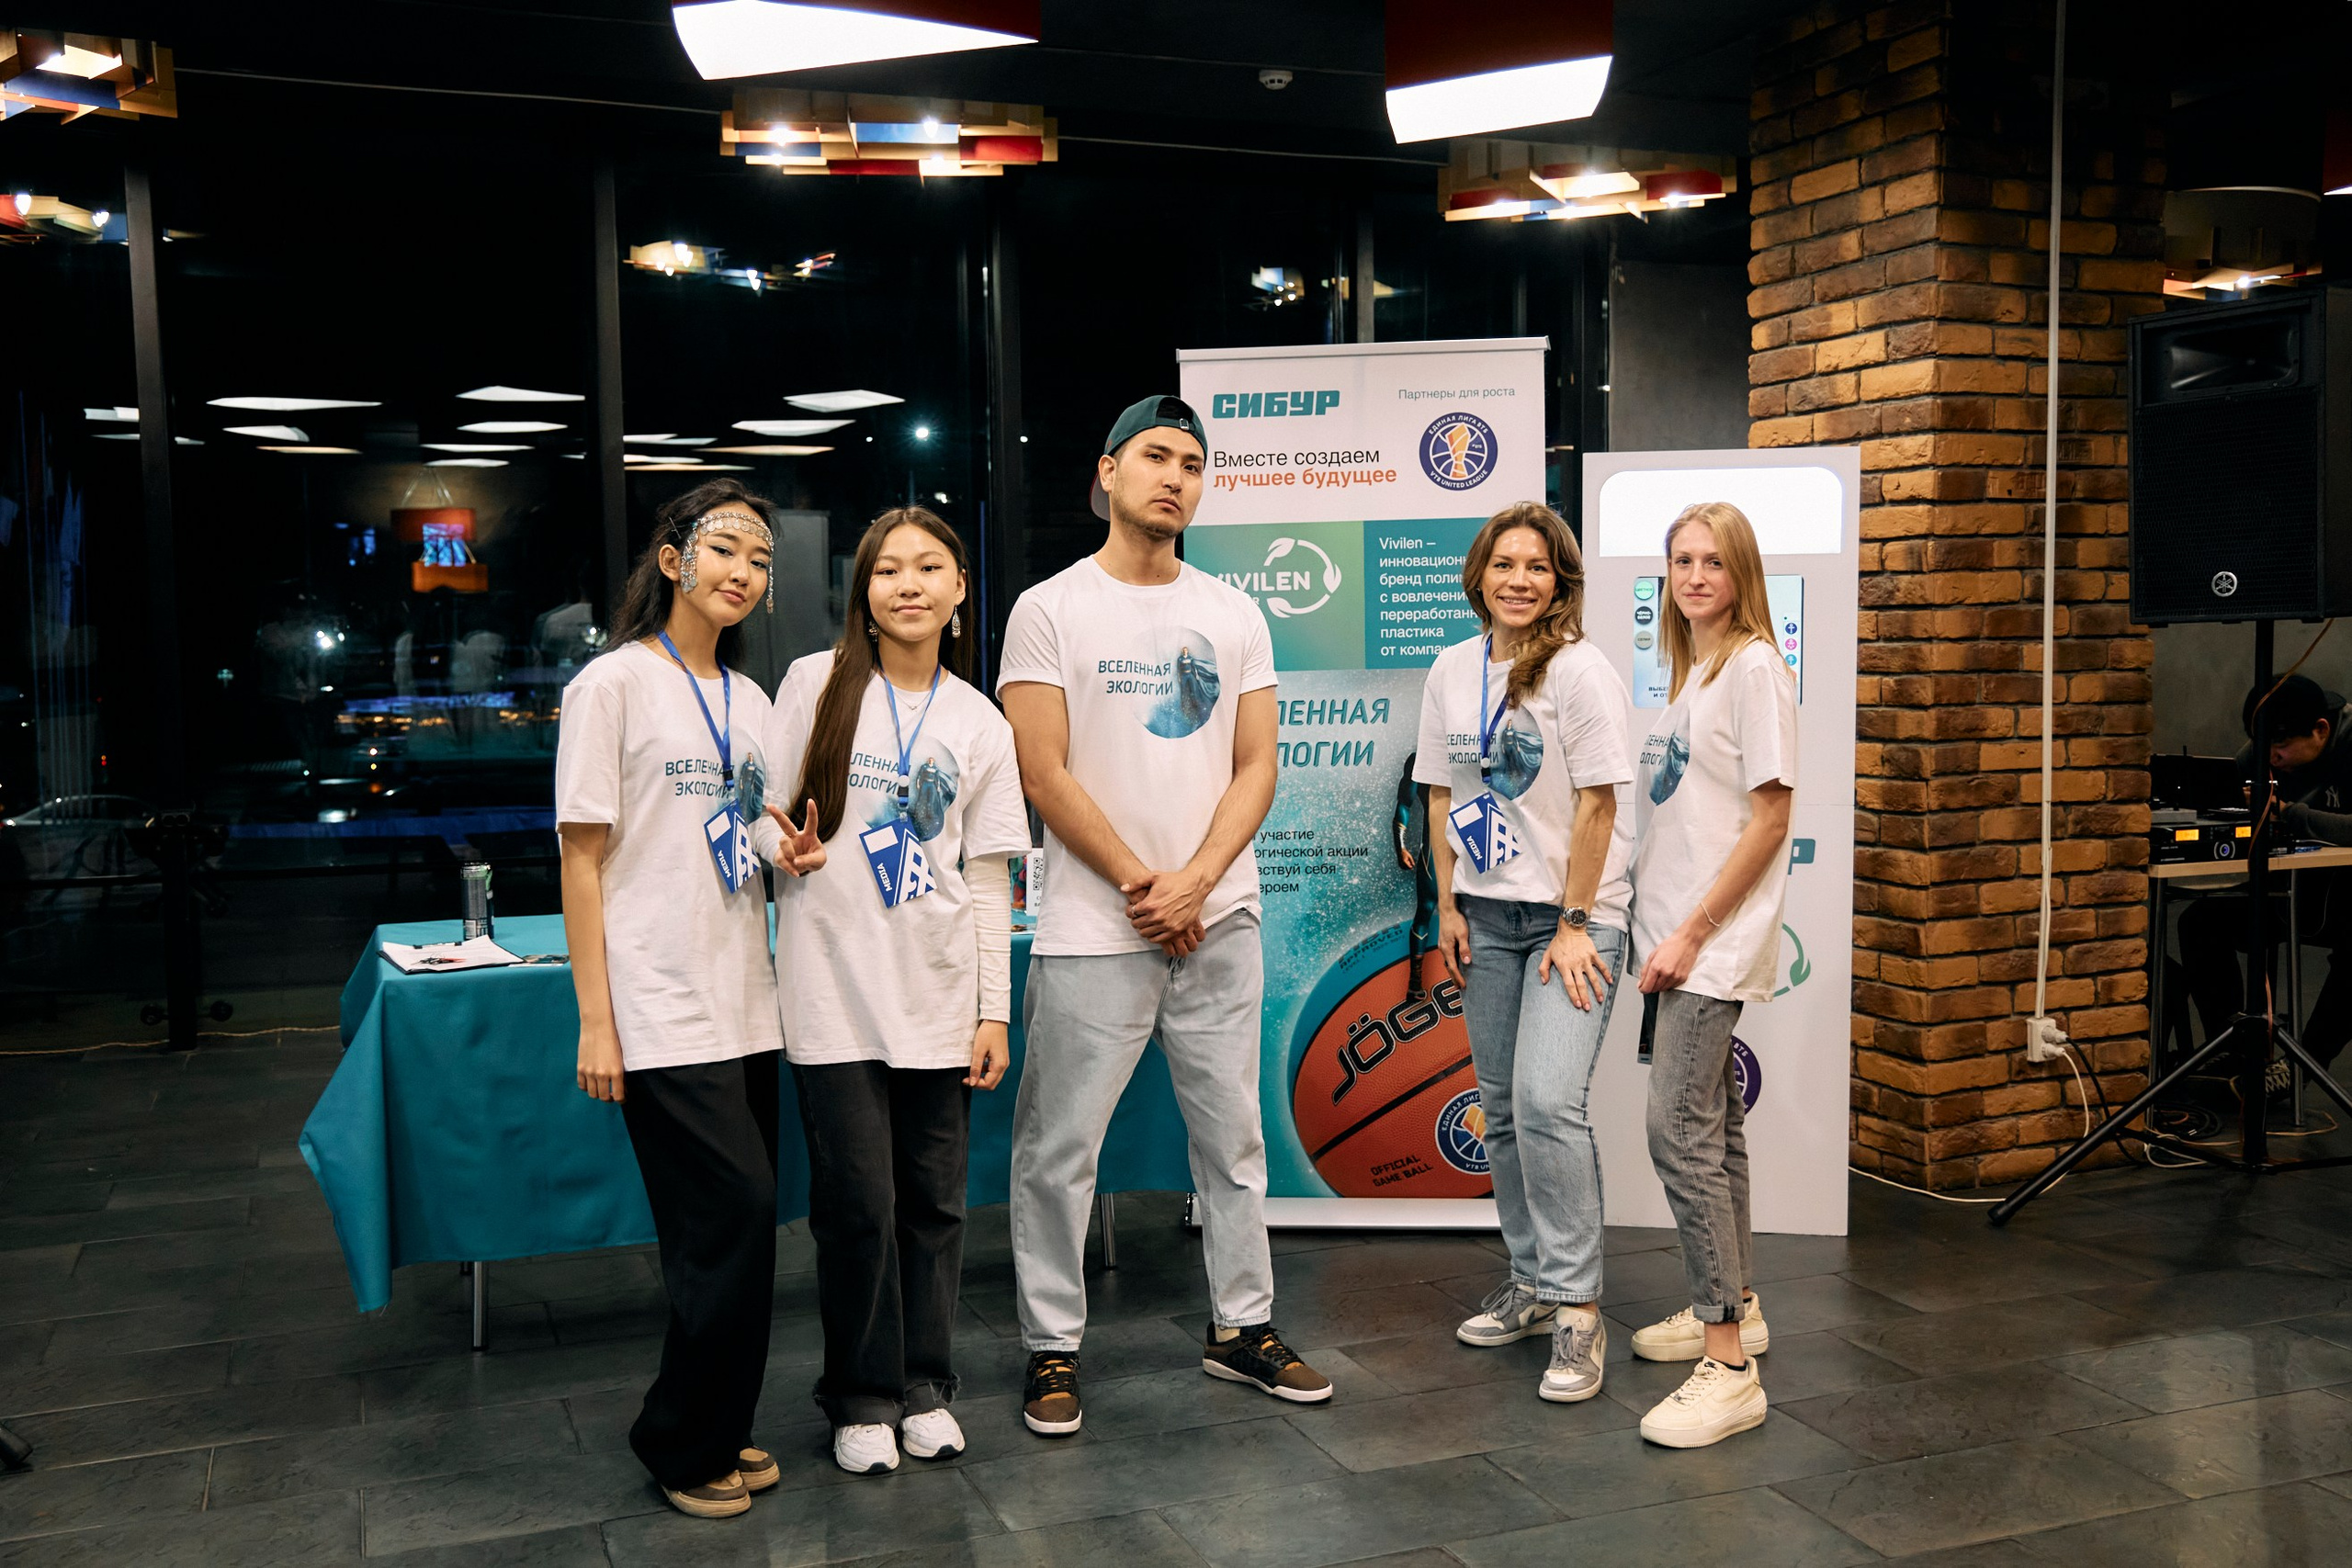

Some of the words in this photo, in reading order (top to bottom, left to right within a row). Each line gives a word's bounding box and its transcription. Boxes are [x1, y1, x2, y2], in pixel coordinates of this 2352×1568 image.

[1212, 389, 1340, 419] СИБУР
[1398, 389, 1456, 401] Партнеры
[1459, 389, 1479, 399] для
[1483, 388, 1516, 400] роста
[1428, 415, 1456, 434] ЕДИНАЯ
[1458, 414, 1476, 424] ЛИГА
[1476, 422, 1489, 434] ВТБ
[1214, 450, 1288, 468] Вместе
[1295, 449, 1380, 468] создаем
[1214, 472, 1295, 491] лучшее
[1302, 468, 1397, 490] будущее
[1430, 470, 1442, 482] VTB
[1441, 479, 1465, 489] UNITED
[1465, 469, 1488, 487] LEAGUE
[1379, 536, 1423, 550] Vivilen
[1379, 572, 1422, 589] бренд
[1380, 592, 1388, 603] с
[1392, 591, 1469, 603] вовлечени
[1380, 607, 1478, 624] переработанн
[1380, 626, 1445, 639] пластика
[1380, 646, 1396, 656] от
[1400, 645, 1448, 656] компа
[1098, 660, 1171, 677] ВСЕЛЕННАЯ
[1106, 680, 1173, 696] ЭКОЛОГИИ
[1277, 698, 1390, 726] ЛЕННАЯ
[851, 752, 911, 775] ЛЕННА
[1277, 740, 1374, 768] ЛОГИИ
[849, 773, 899, 795] ОЛОГИ
[1260, 830, 1315, 844] участие
[1254, 845, 1323, 859] огической
[1327, 847, 1369, 859] акции
[1466, 835, 1483, 861] MEDIA
[718, 850, 732, 878] MEDIA
[1257, 863, 1301, 878] вствуй
[1305, 863, 1337, 874] себя
[876, 862, 893, 892] MEDIA
[1260, 883, 1300, 896] ероем
[1331, 977, 1464, 1106] JÖGE
[1733, 1042, 1748, 1057] ВТБ
[1441, 1101, 1463, 1132] ЕДИНАЯ
[1463, 1093, 1480, 1103] ЛИГ
[1370, 1155, 1421, 1176] OFFICIAL
[1373, 1173, 1402, 1187] GAME
[1402, 1163, 1434, 1179] BALL
[1465, 1162, 1479, 1170] VTB
